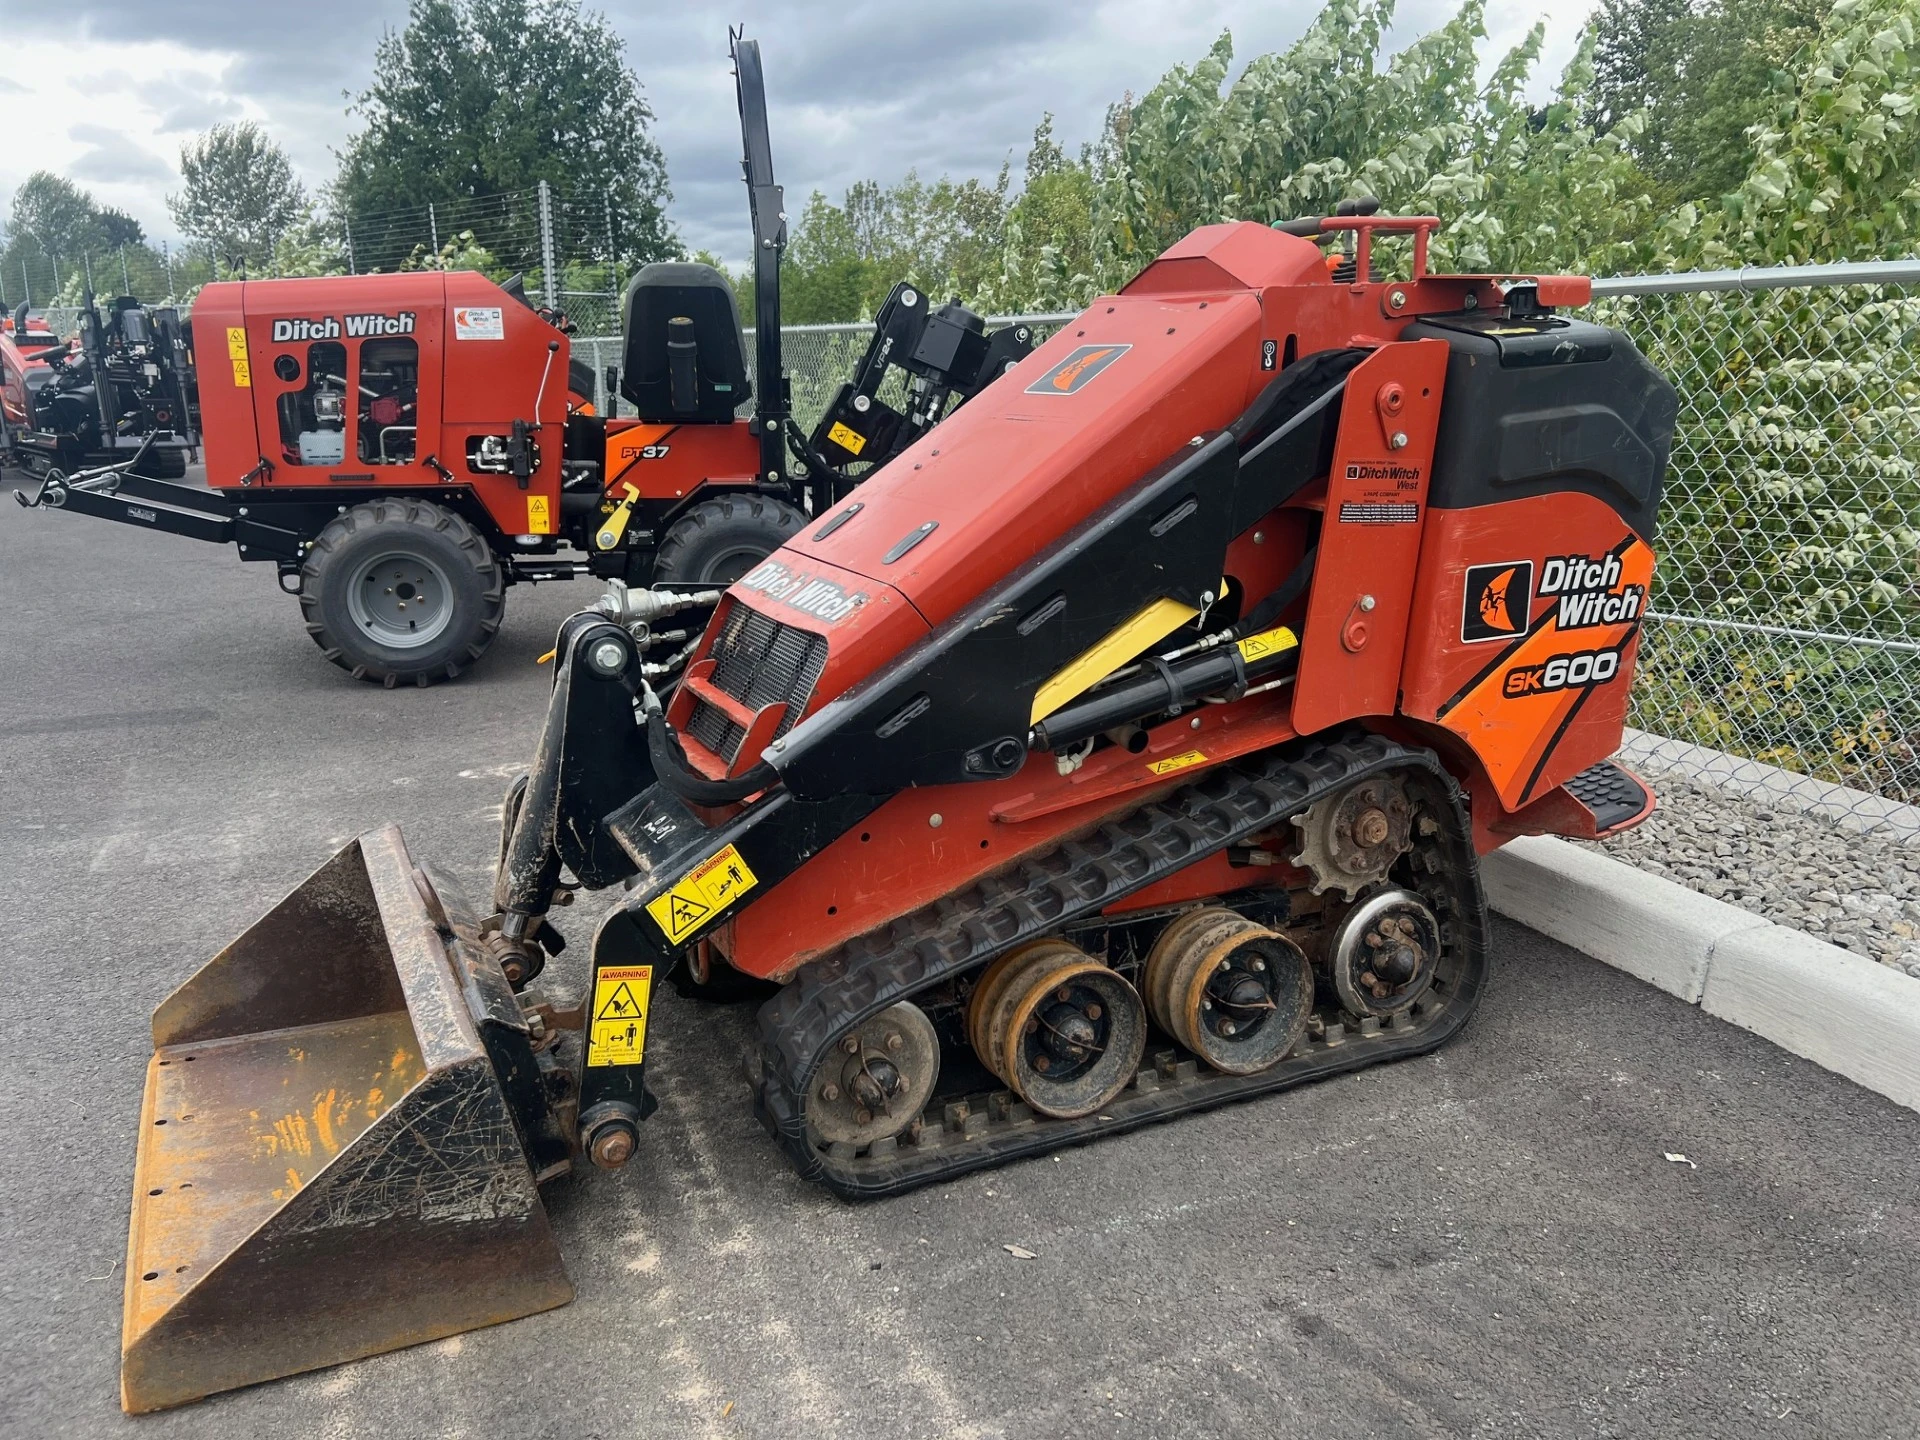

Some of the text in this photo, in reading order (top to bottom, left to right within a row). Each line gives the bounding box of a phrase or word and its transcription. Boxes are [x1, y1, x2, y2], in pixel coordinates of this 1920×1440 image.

[273, 313, 414, 341] Ditch Witch
[874, 336, 894, 369] VP24
[621, 446, 670, 459] PT37
[1359, 467, 1420, 479] Ditch Witch
[1397, 481, 1418, 490] West
[1539, 554, 1621, 594] Ditch
[1558, 586, 1640, 628] Witch
[1506, 651, 1618, 693] SK600
[700, 850, 731, 874] WARNING
[609, 970, 648, 979] WARNING
